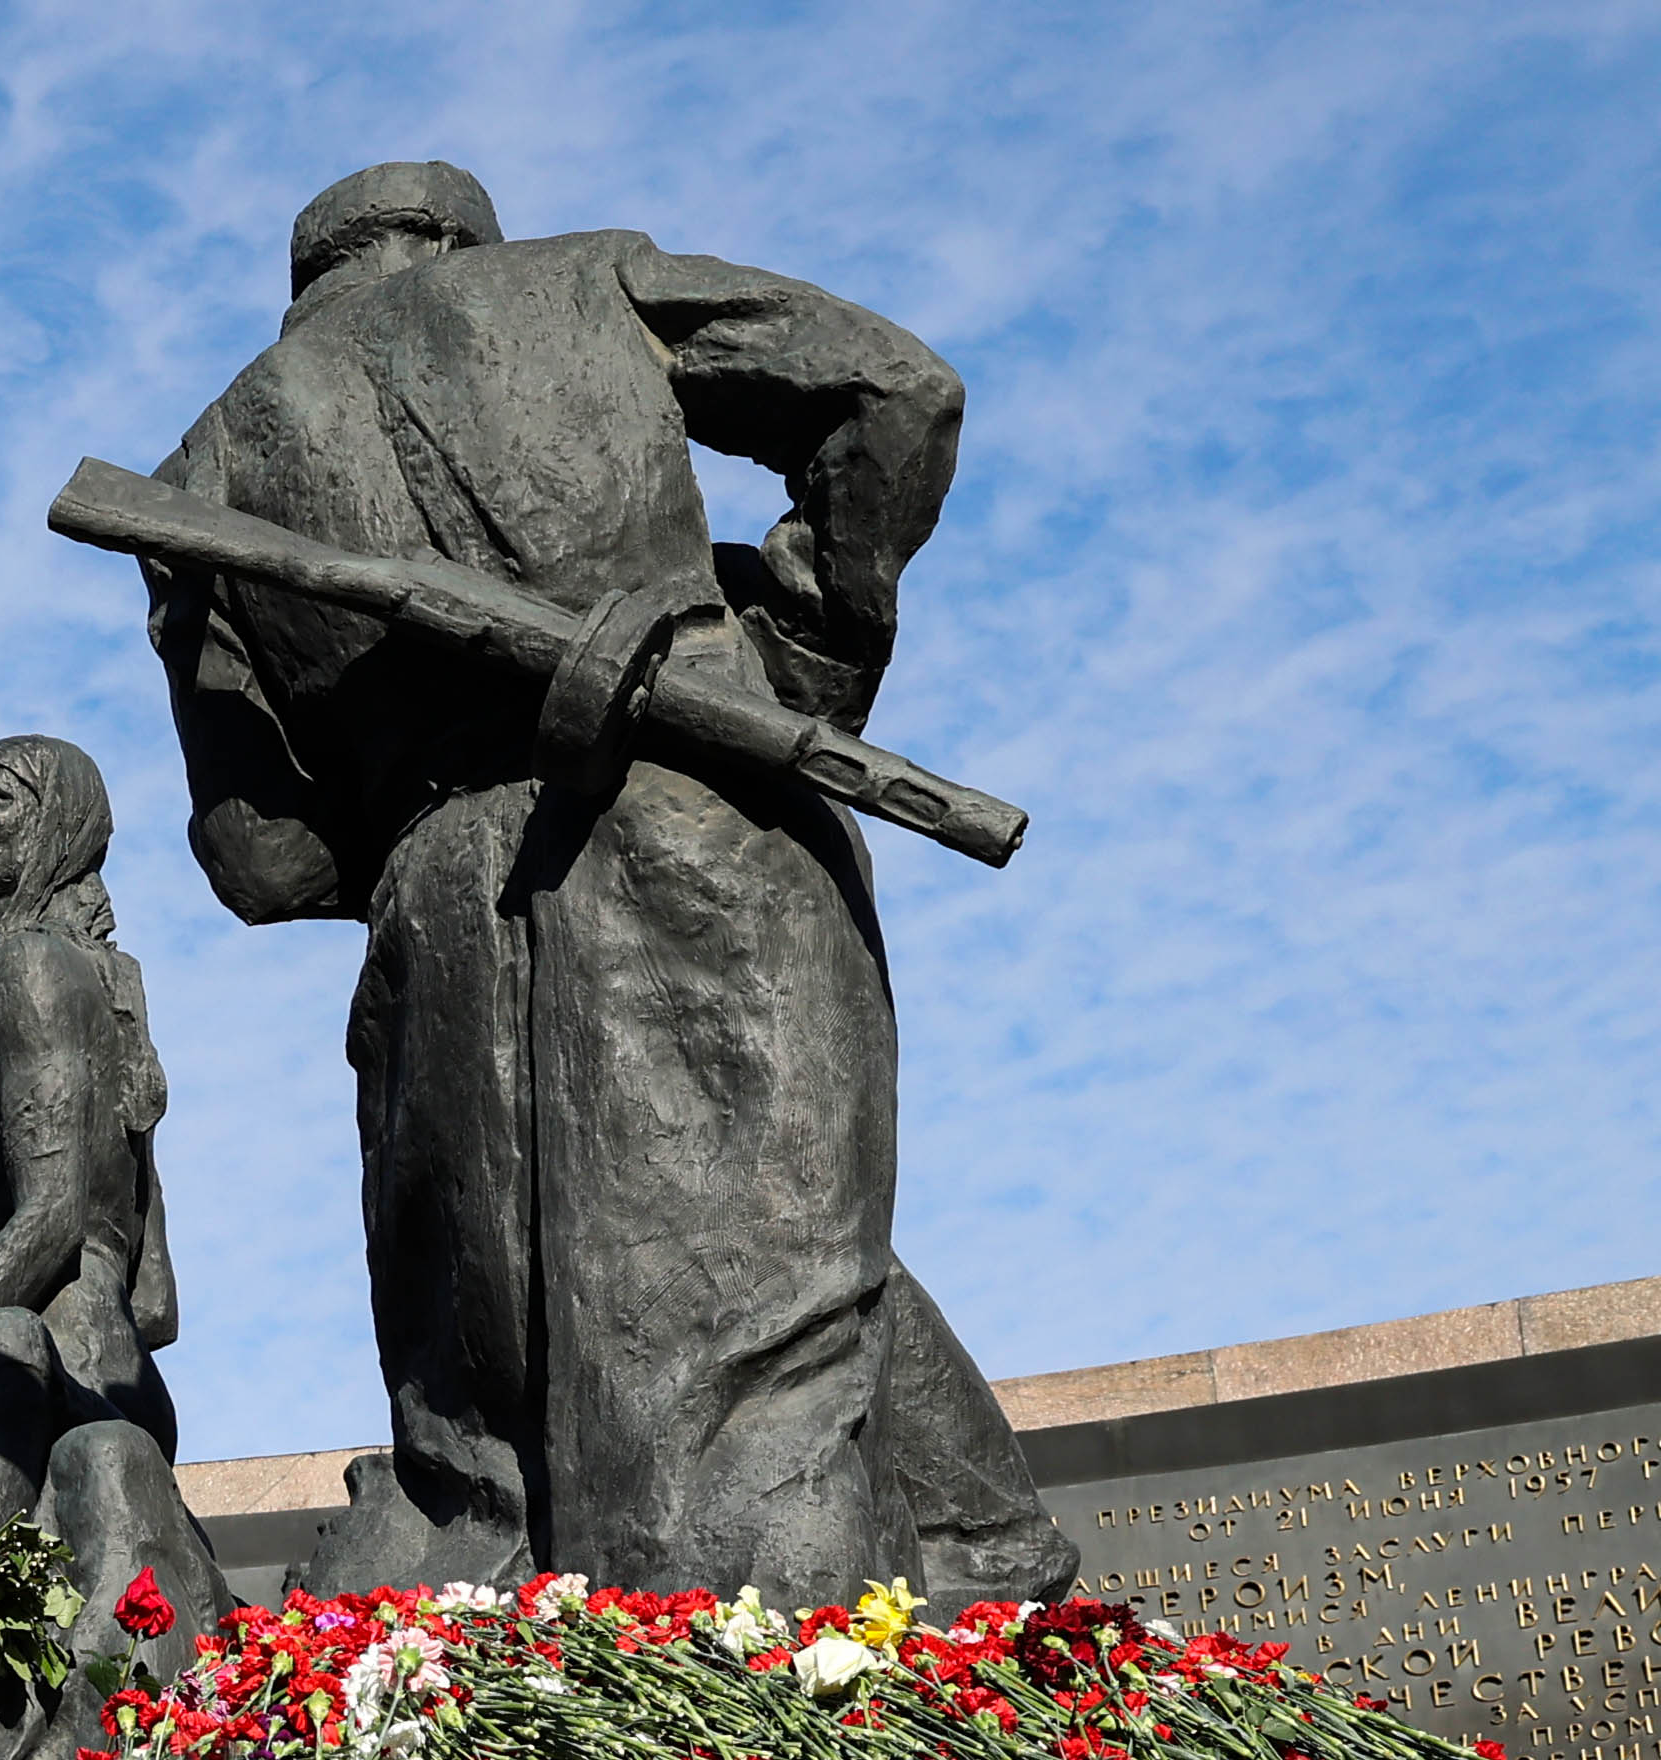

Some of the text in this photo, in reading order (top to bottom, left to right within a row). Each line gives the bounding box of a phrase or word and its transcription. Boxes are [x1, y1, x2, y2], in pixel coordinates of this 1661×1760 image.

[1098, 1437, 1661, 1529] ПРЕЗИДИУМА ВЕРХОВНОГ
[1189, 1519, 1237, 1542] ОТ
[1277, 1507, 1309, 1531] 21
[1348, 1487, 1465, 1521] ИЮНЯ
[1509, 1466, 1598, 1500] 1957
[1325, 1522, 1513, 1567] ЗАСЛУГИ
[1563, 1501, 1661, 1535] ПЕР
[1316, 1634, 1334, 1654] В
[1373, 1616, 1460, 1648] ДНИ
[1489, 1702, 1540, 1726] ЗА
